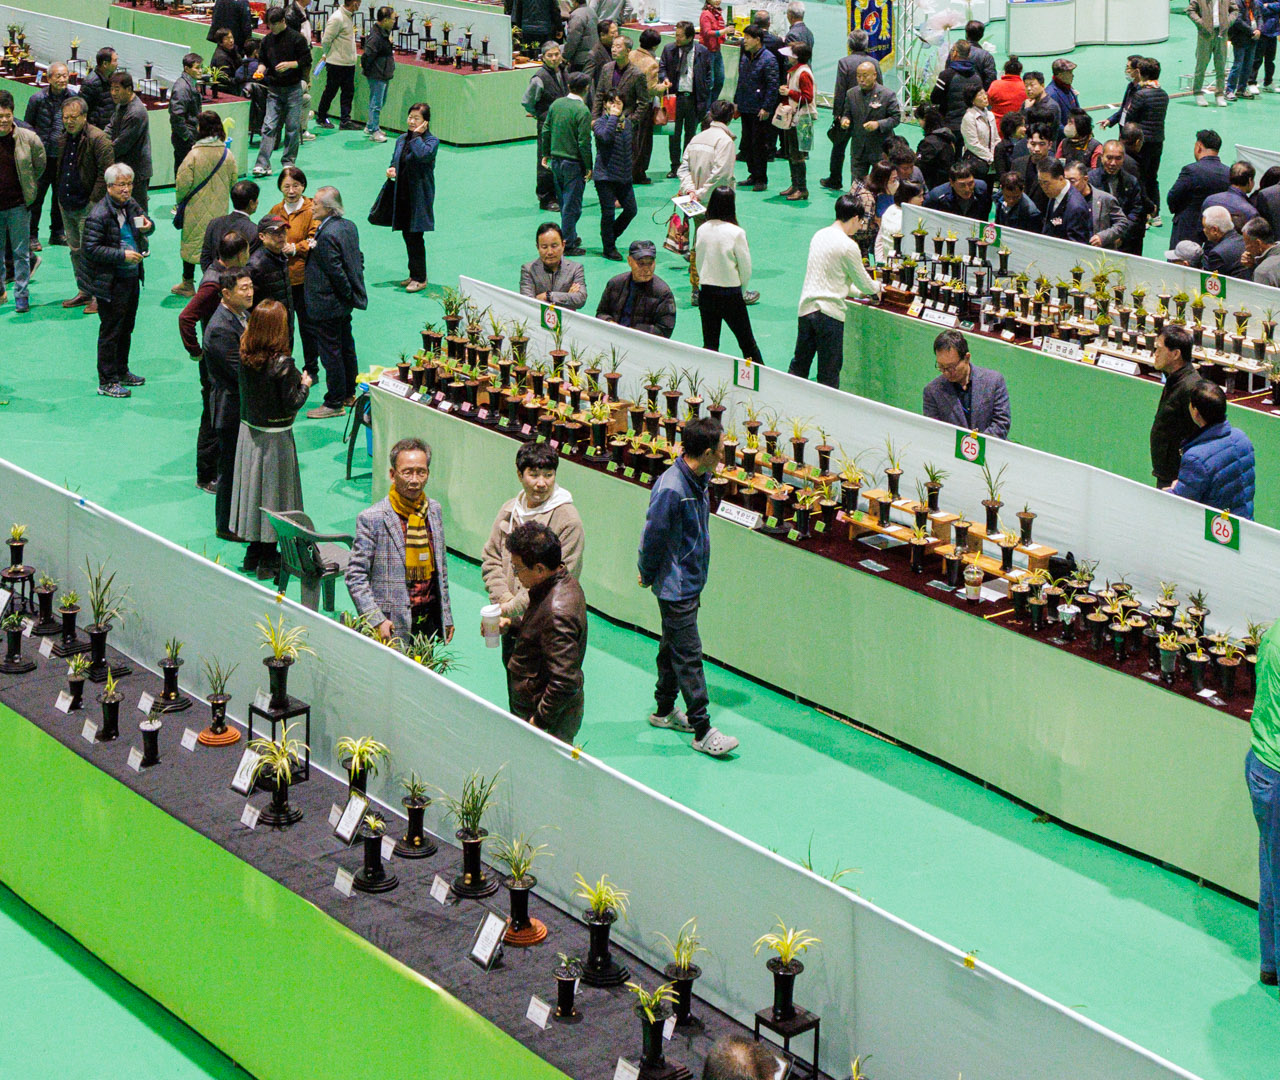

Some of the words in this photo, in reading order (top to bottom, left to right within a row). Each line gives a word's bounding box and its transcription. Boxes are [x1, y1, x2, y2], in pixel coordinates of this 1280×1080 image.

[1207, 280, 1220, 291] 36
[546, 312, 556, 325] 23
[740, 369, 751, 381] 24
[964, 441, 977, 456] 25
[1215, 522, 1230, 538] 26
